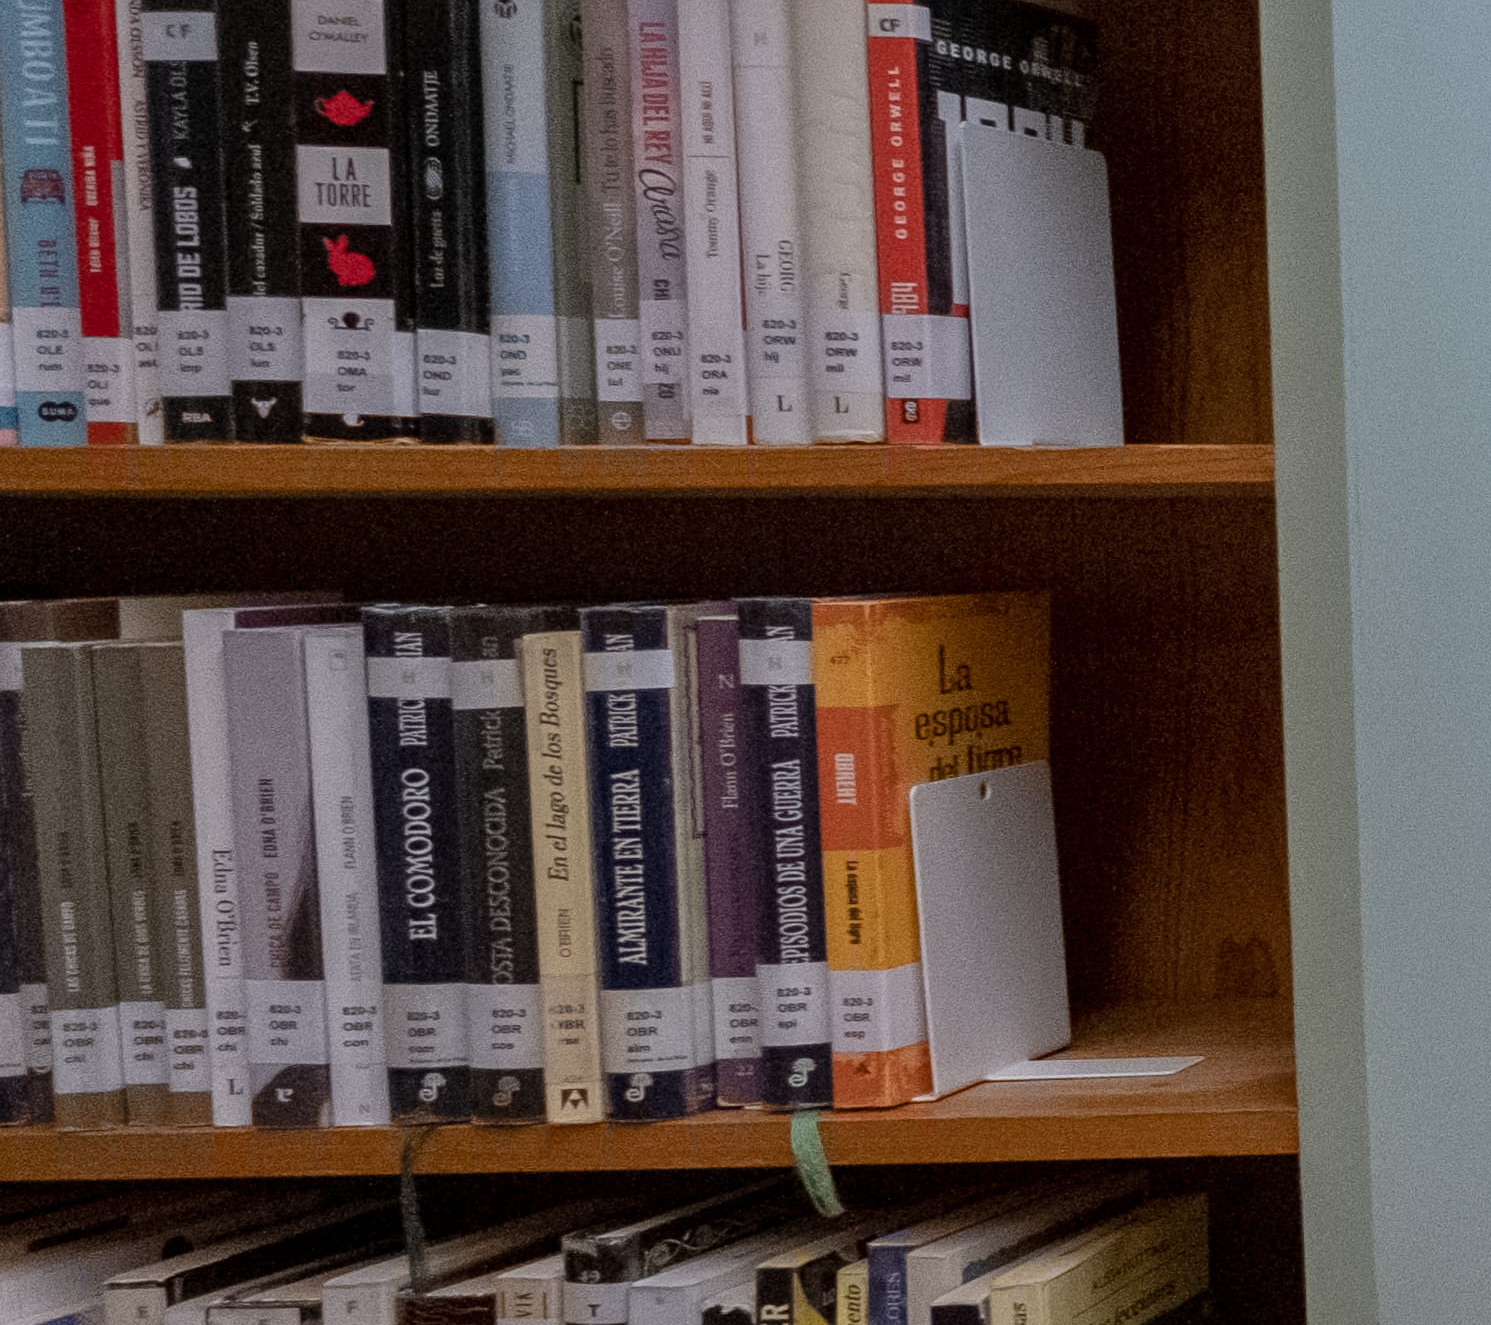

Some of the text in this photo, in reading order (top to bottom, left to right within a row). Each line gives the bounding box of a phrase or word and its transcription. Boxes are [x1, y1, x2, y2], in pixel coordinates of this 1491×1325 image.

[639, 22, 667, 42] LA
[879, 17, 901, 33] CF
[245, 41, 259, 78] Olsen
[22, 85, 58, 108] A
[423, 70, 441, 148] ONDAATJE
[641, 93, 671, 126] DEL
[643, 129, 673, 165] REY
[887, 65, 909, 240] GEORGE ORWELL
[331, 156, 357, 182] LA
[315, 181, 371, 208] TORRE
[173, 186, 202, 278] DE LOBOS
[539, 647, 570, 882] En el lago de los Bosques
[770, 758, 804, 822] GUERRA
[605, 693, 647, 965] ALMIRANTE EN TIERRA PATRICK
[774, 824, 806, 859] UNA
[401, 767, 438, 941] EL COMODORO
[774, 860, 808, 882] DE
[775, 885, 811, 964] EPISODIOS
